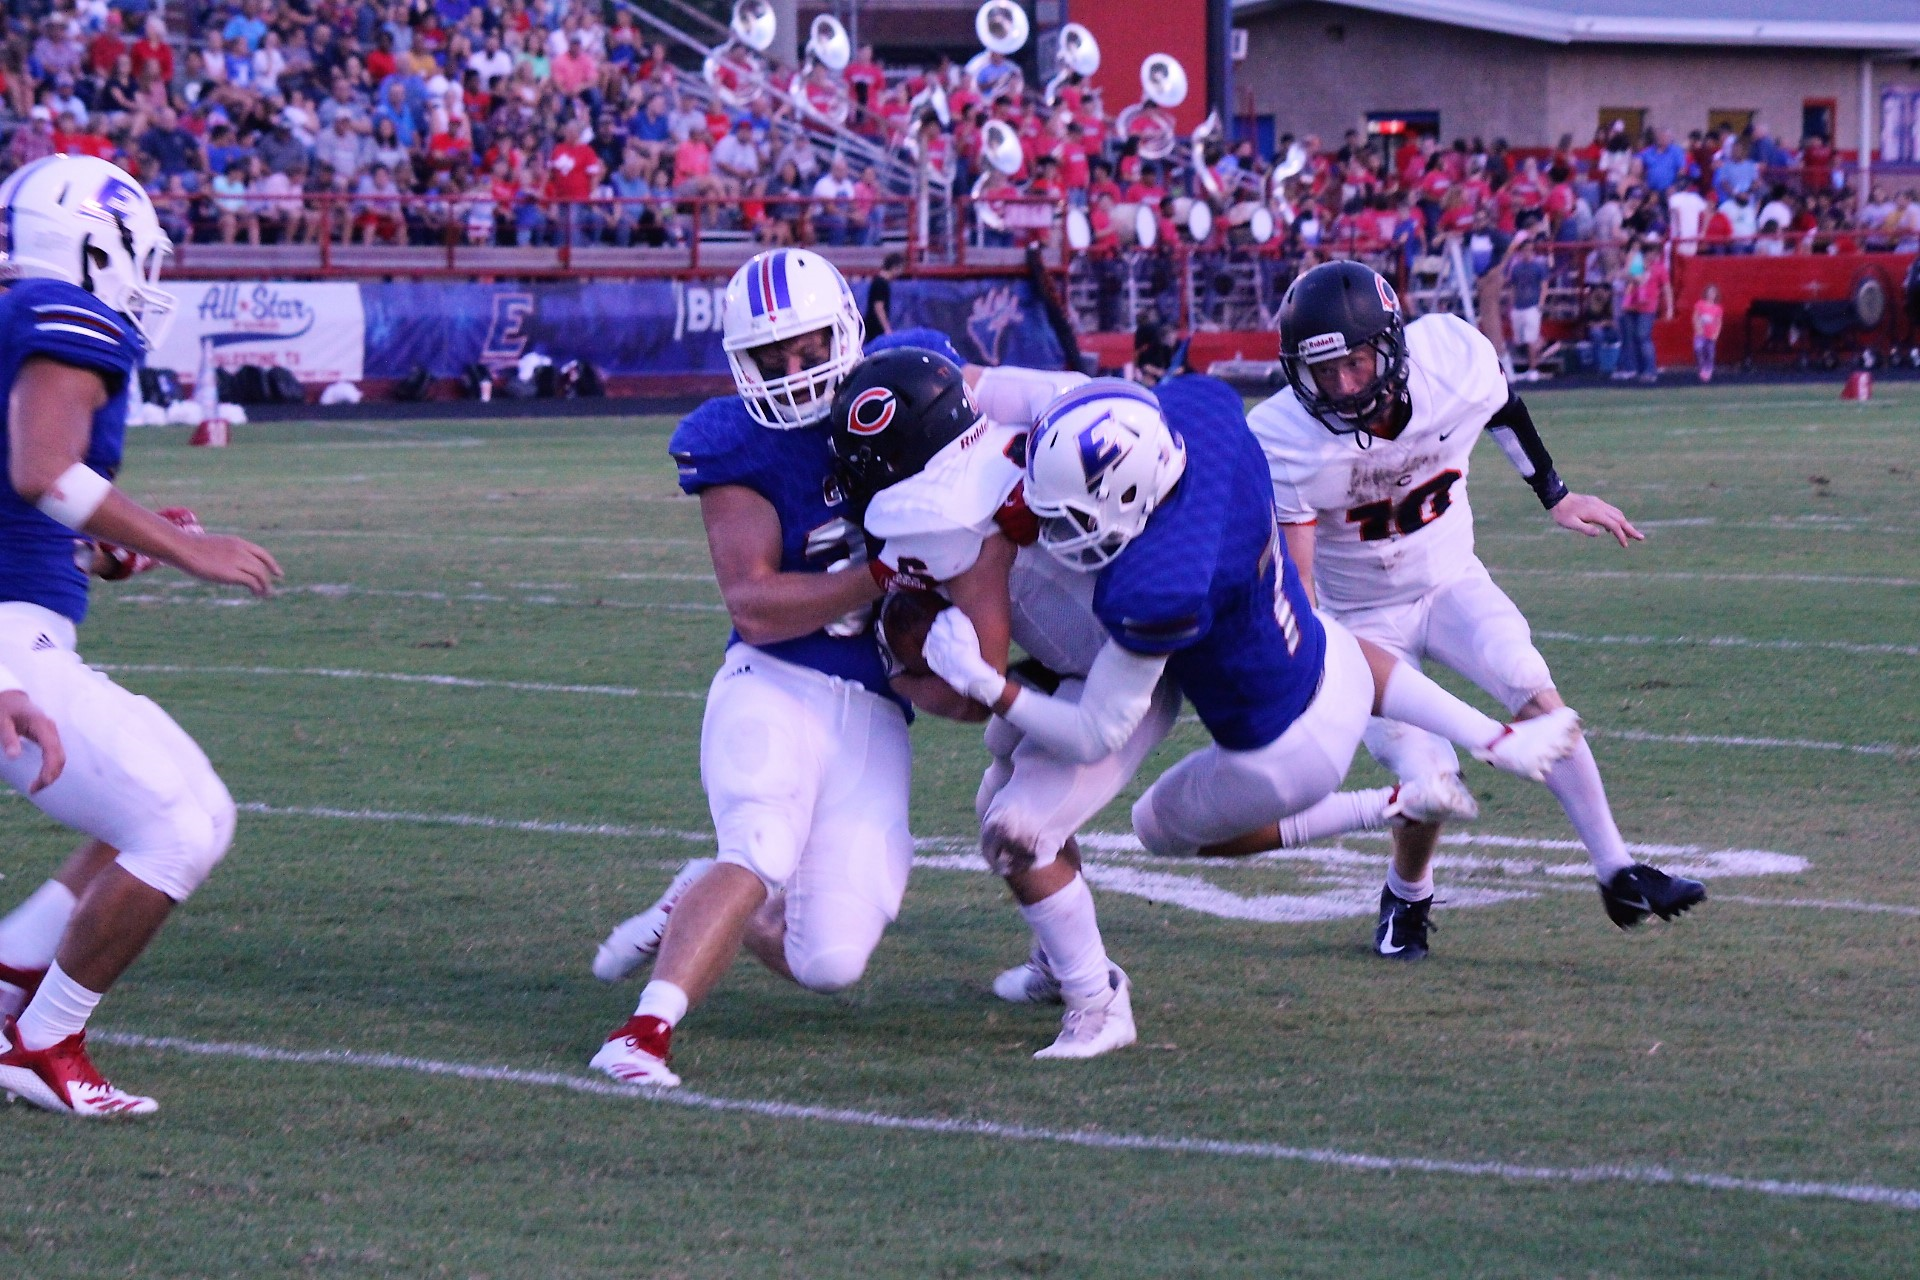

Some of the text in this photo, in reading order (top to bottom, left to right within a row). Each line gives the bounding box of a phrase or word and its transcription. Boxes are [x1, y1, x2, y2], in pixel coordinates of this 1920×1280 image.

[198, 284, 307, 320] All Star
[478, 292, 534, 364] E
[1309, 336, 1334, 348] Riddell
[847, 386, 897, 436] C
[1345, 468, 1462, 541] 10
